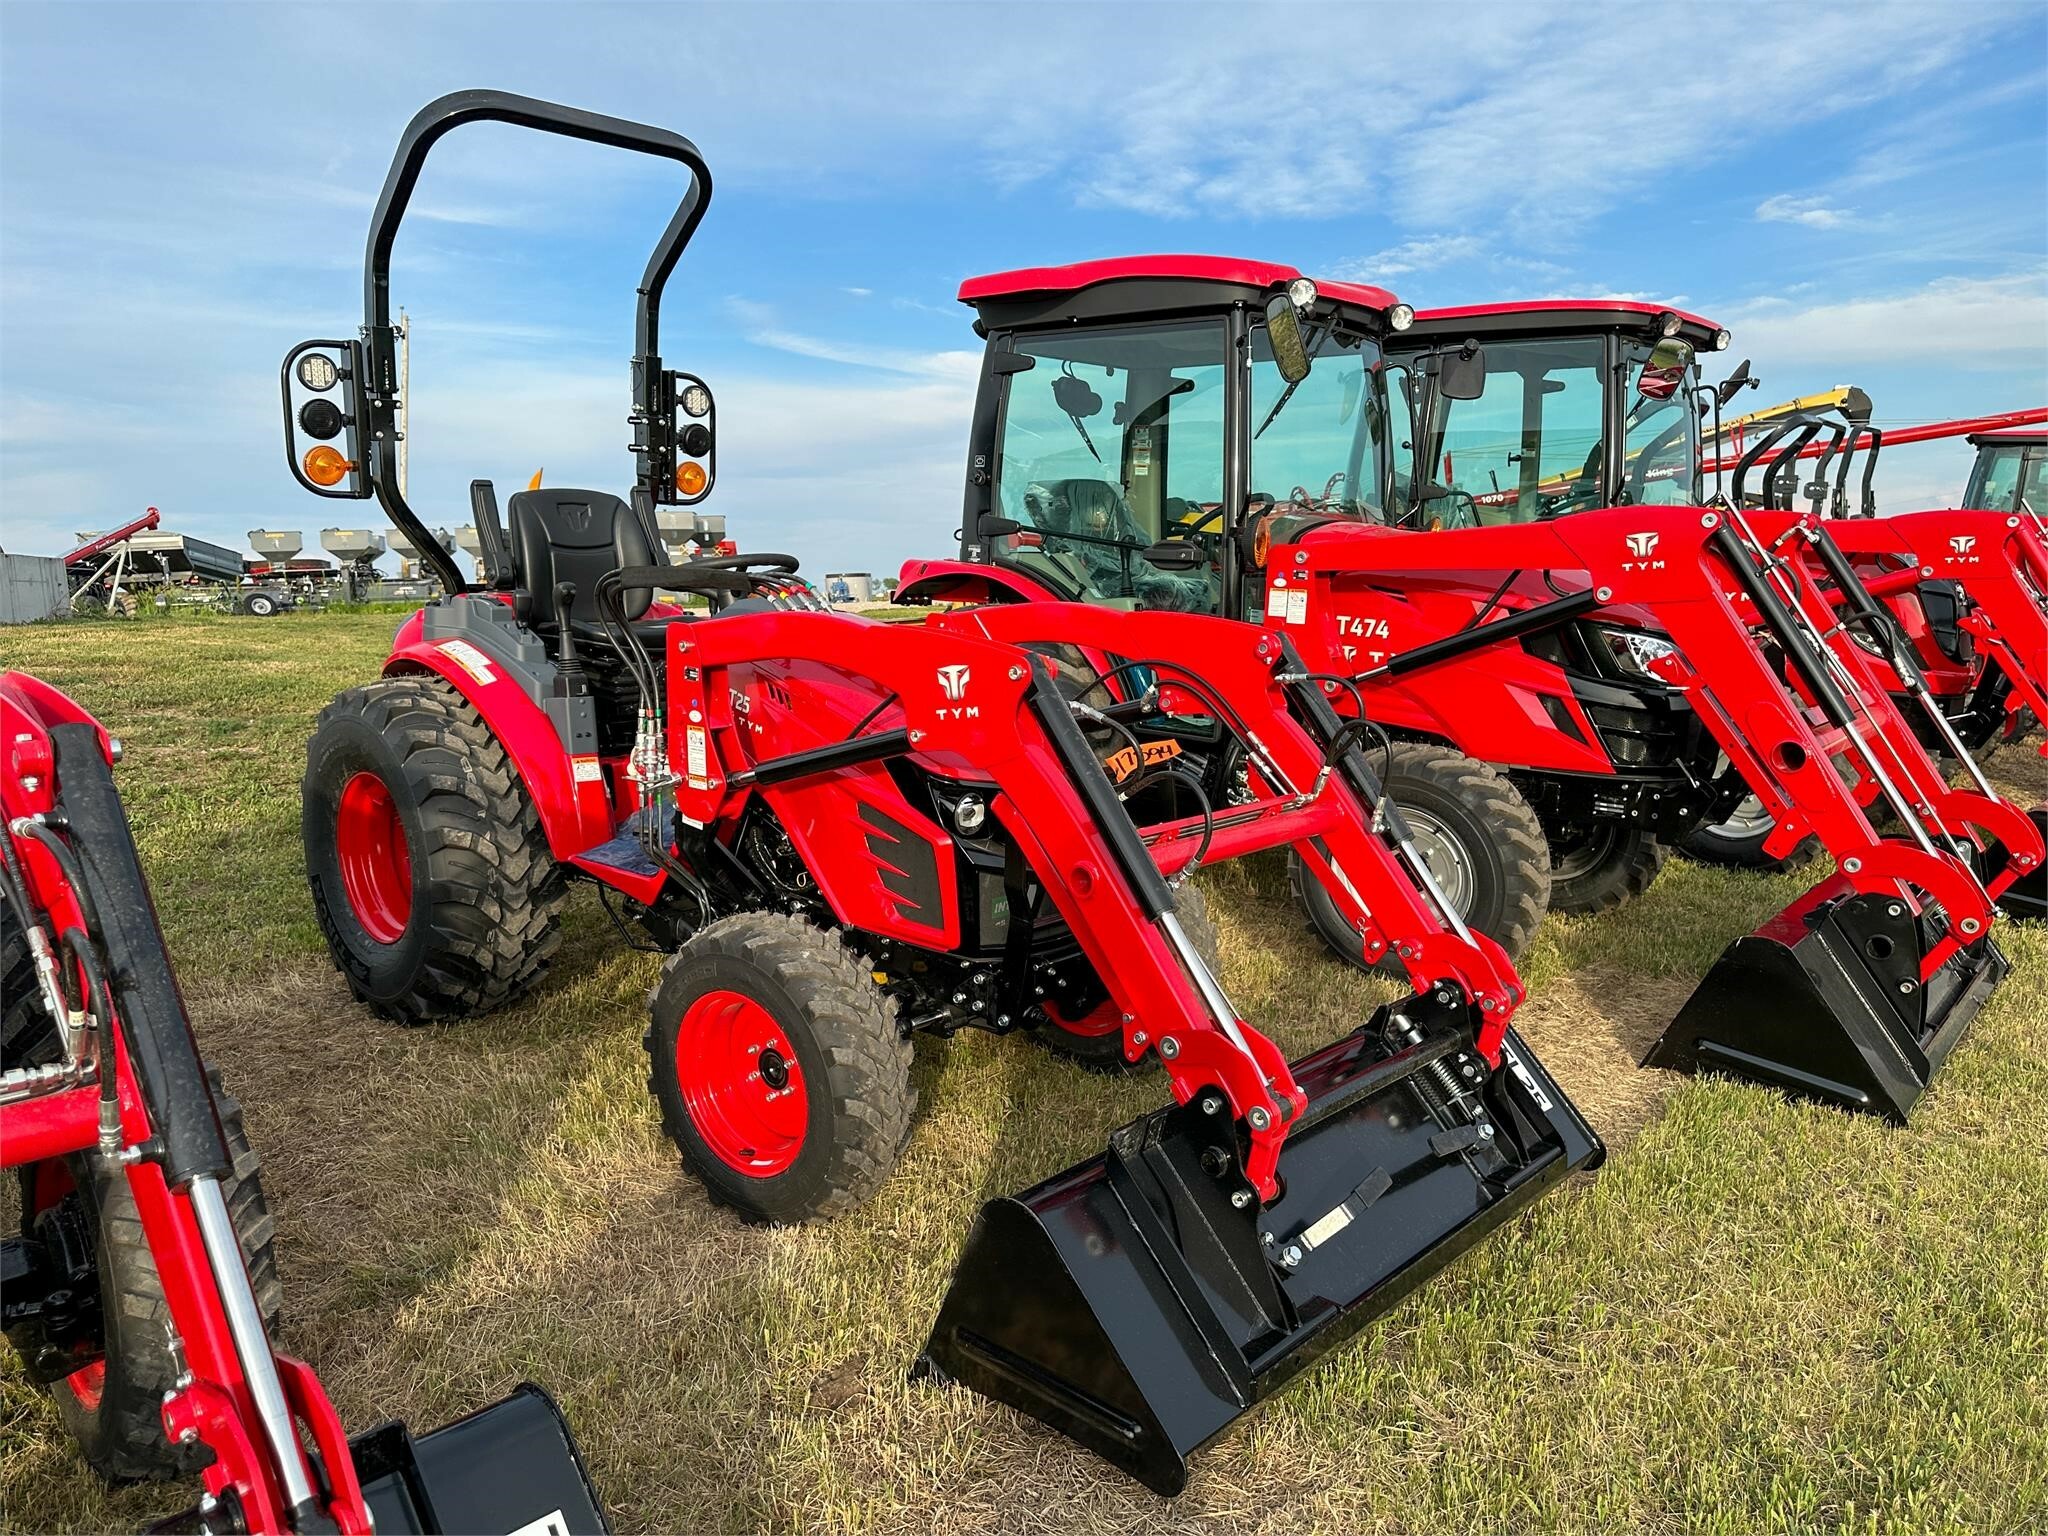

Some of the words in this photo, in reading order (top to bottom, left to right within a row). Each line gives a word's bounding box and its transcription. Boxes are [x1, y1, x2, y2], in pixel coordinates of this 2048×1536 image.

[1481, 494, 1504, 504] 1070
[1622, 560, 1665, 571] TYM
[1336, 615, 1389, 639] T474
[728, 688, 751, 713] T25
[936, 706, 979, 720] TYM
[738, 716, 763, 734] TYM
